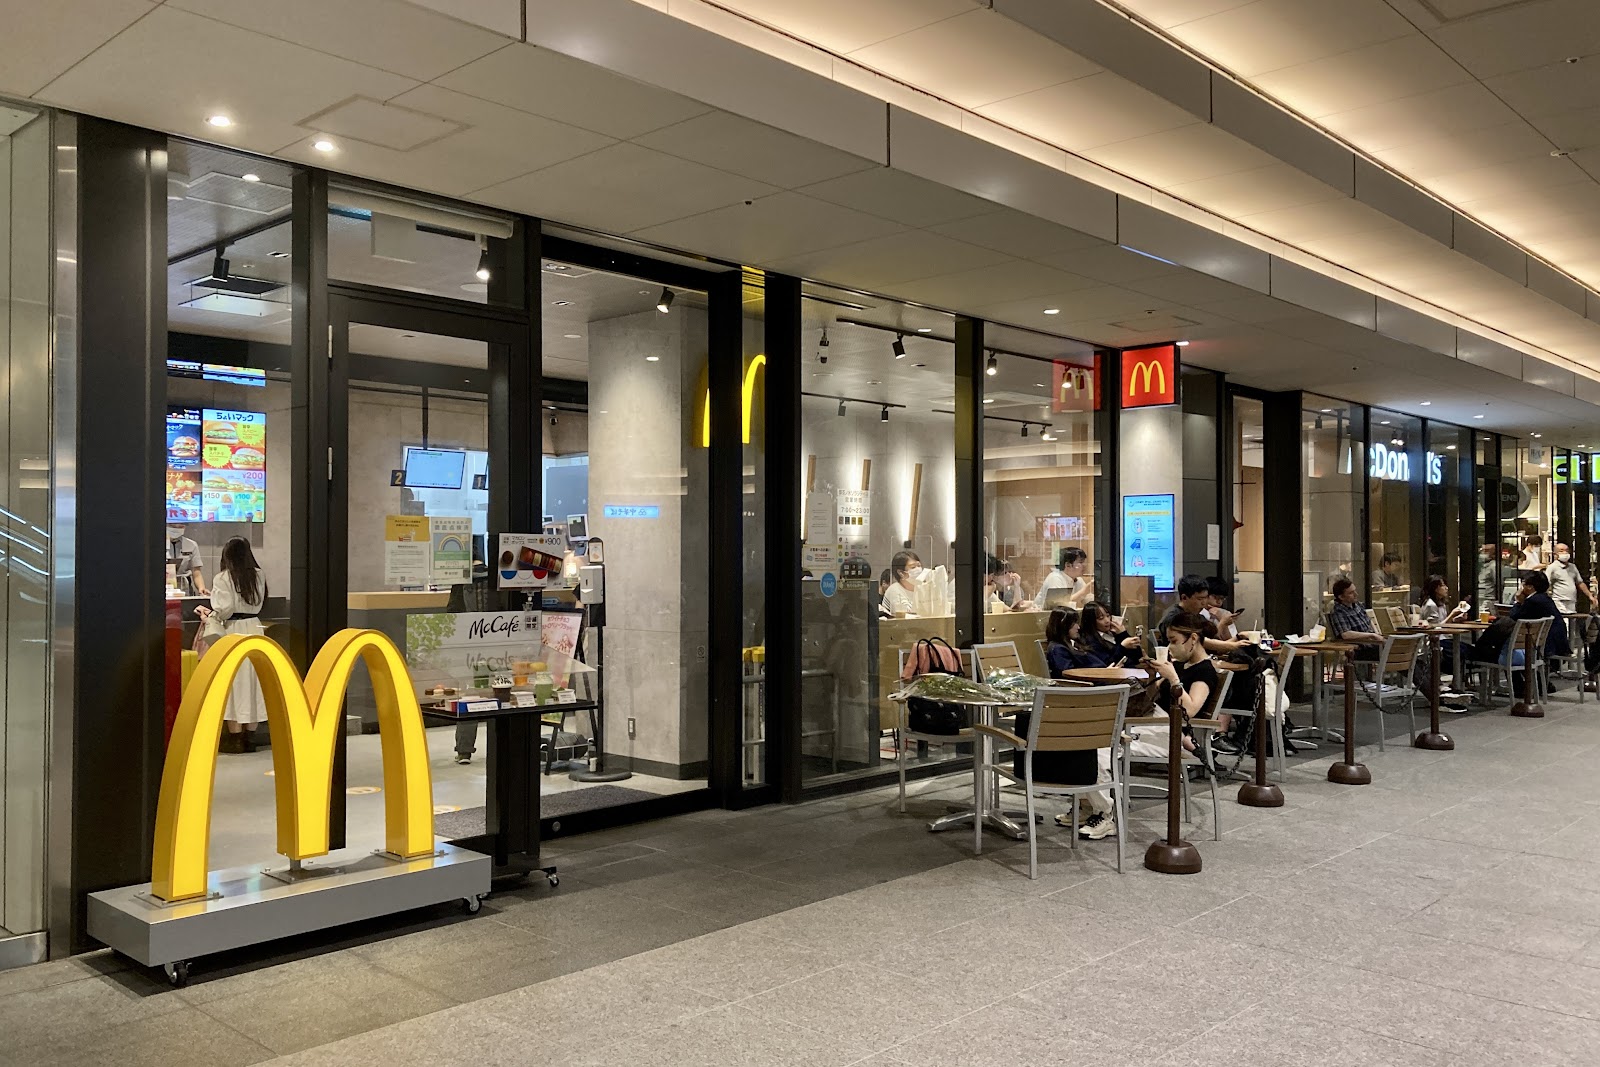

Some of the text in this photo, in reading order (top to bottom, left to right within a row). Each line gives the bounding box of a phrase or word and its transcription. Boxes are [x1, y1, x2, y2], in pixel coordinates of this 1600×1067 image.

[216, 412, 254, 422] ちょいマック
[394, 472, 402, 484] 2
